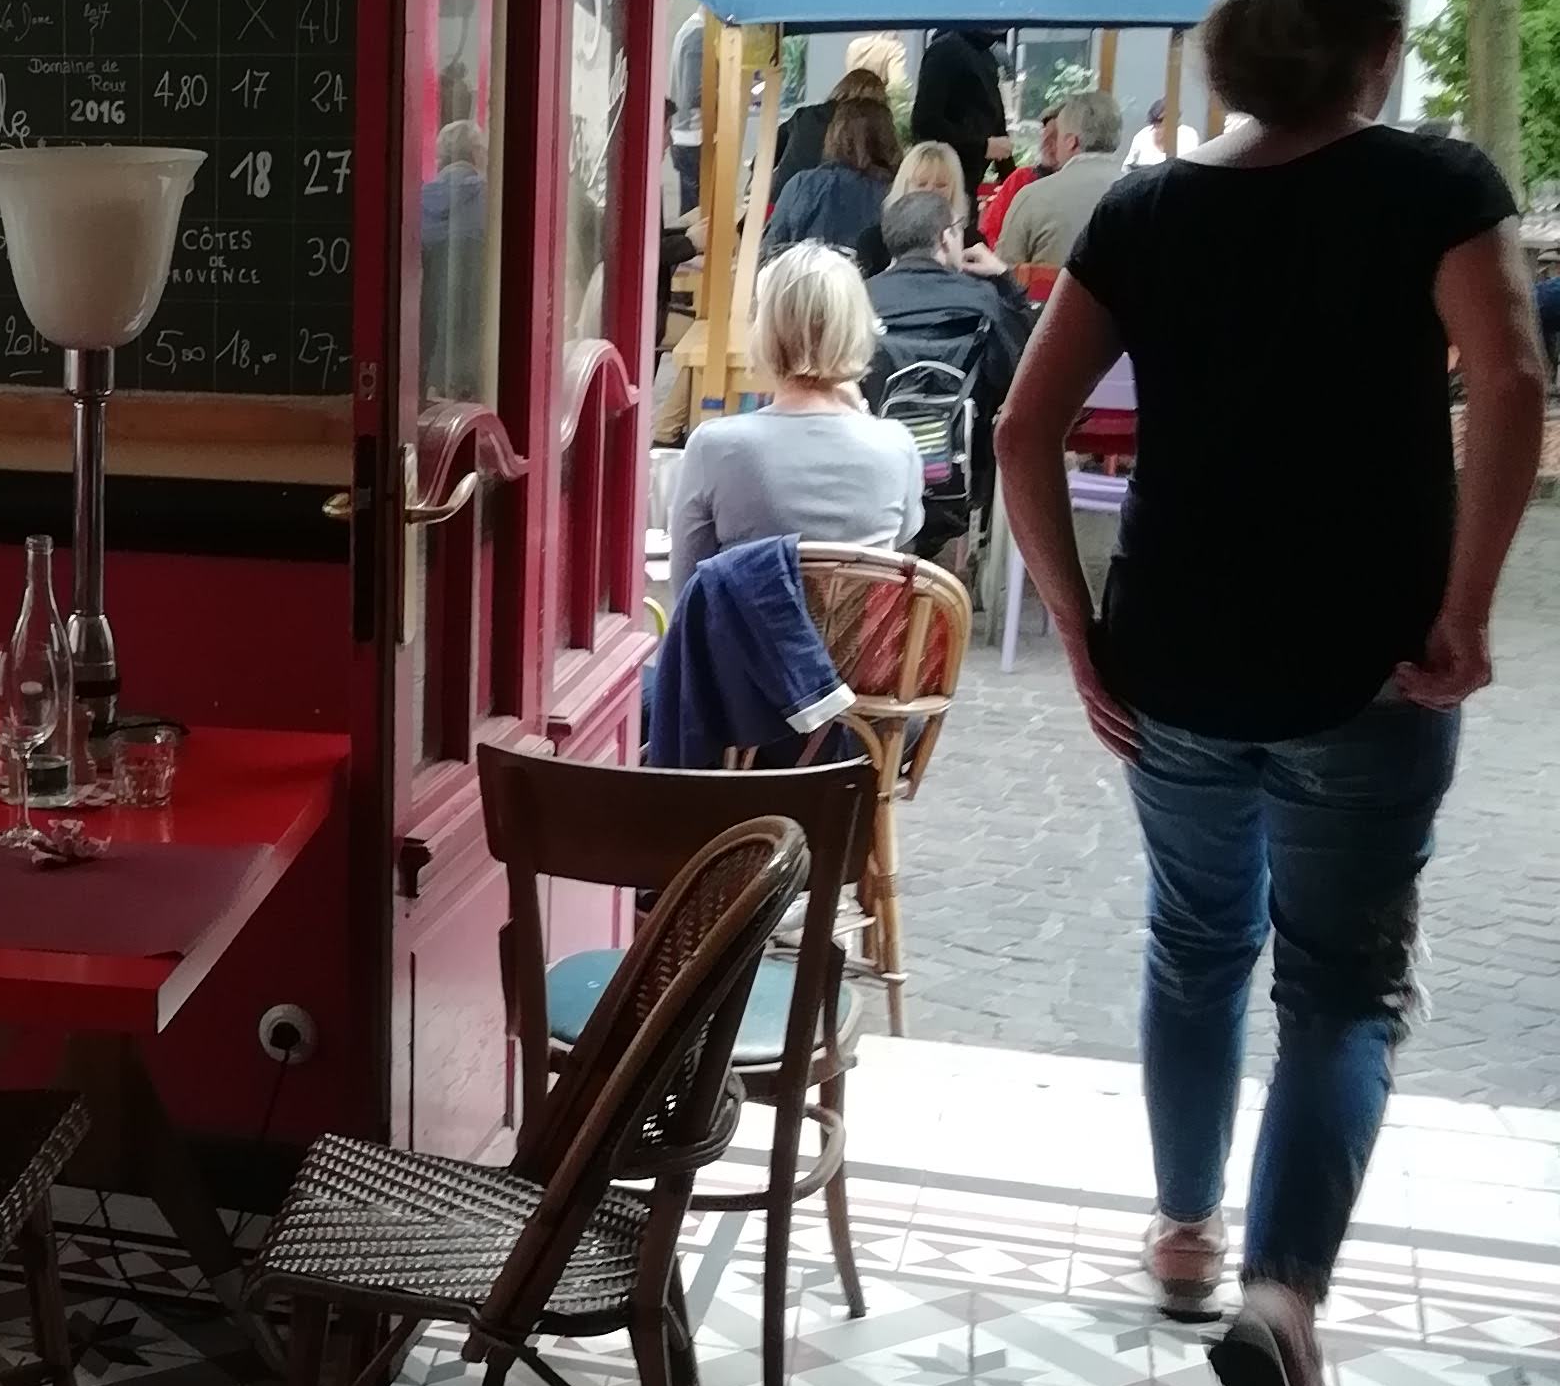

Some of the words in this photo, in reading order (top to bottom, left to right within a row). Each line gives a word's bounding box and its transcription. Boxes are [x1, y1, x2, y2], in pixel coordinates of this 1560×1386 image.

[27, 57, 96, 75] Domaine
[100, 59, 120, 74] de
[230, 70, 271, 110] 17
[310, 70, 350, 113] 24
[69, 98, 127, 125] 2016
[229, 149, 273, 199] 18
[303, 149, 352, 196] 27
[182, 225, 253, 251] CÔTES
[209, 255, 227, 268] DE
[306, 236, 351, 277] 30
[171, 269, 262, 285] ROVENCE
